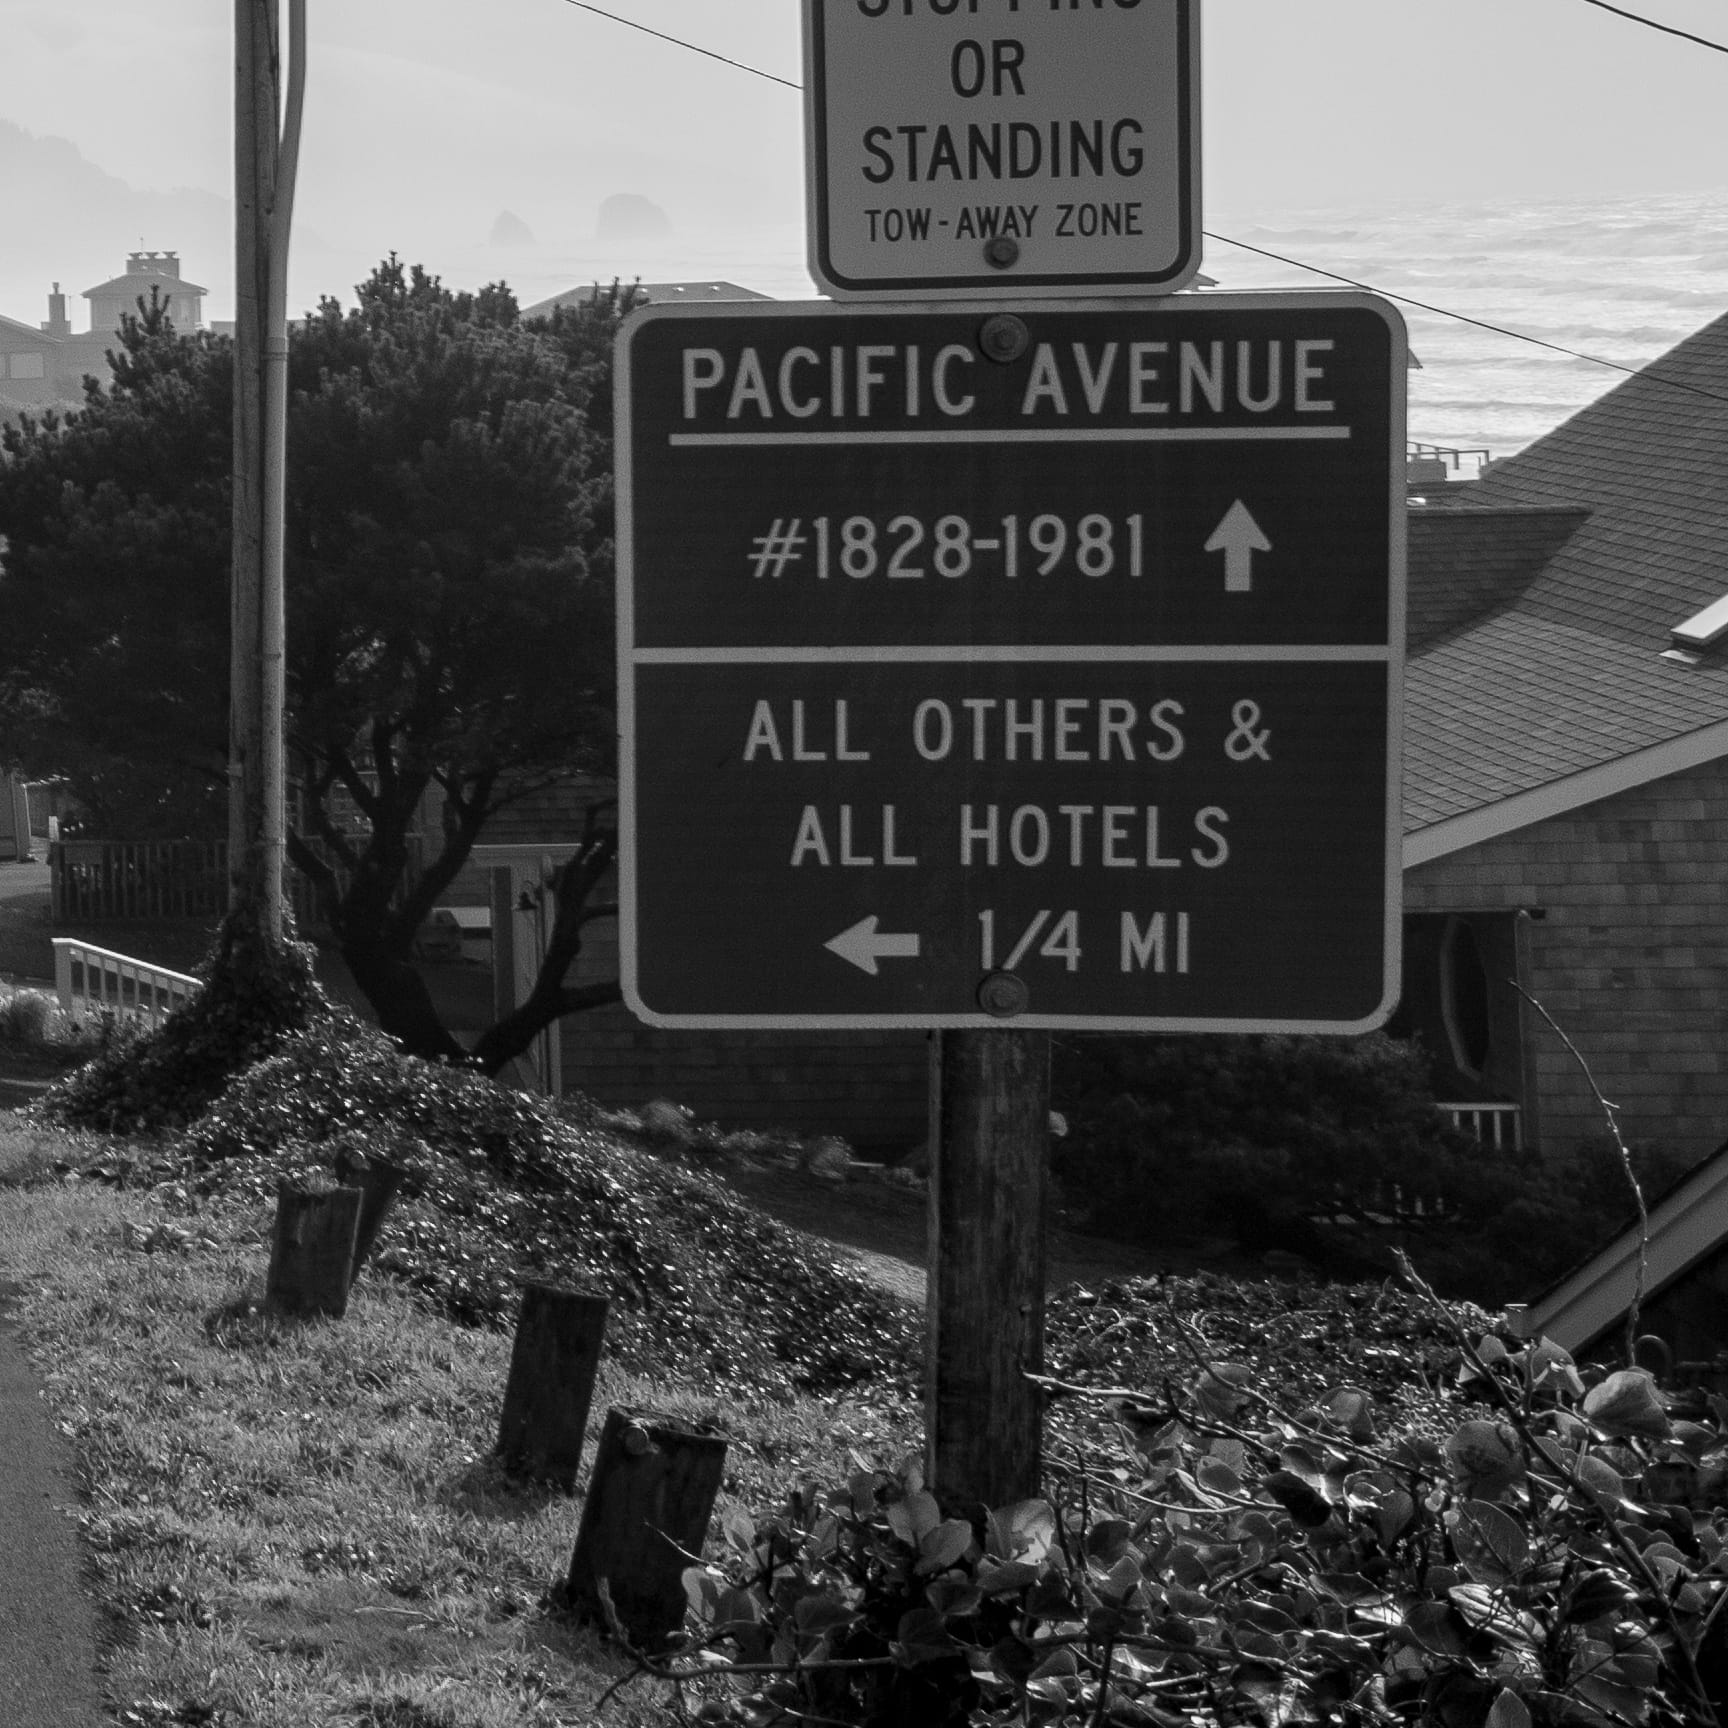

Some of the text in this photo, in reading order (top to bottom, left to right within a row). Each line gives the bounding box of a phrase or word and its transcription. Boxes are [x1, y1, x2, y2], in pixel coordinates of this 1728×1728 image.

[950, 38, 1026, 99] OR
[861, 117, 1145, 184] STANDING
[1055, 202, 1144, 237] ZONE
[681, 339, 1336, 419] PACIFIC AVENUE
[746, 513, 1144, 579] #1828-1981
[743, 698, 1272, 762] ALL OTHERS &
[790, 803, 1230, 868] ALL HOTELS
[978, 909, 1190, 974] 1/4 MI
